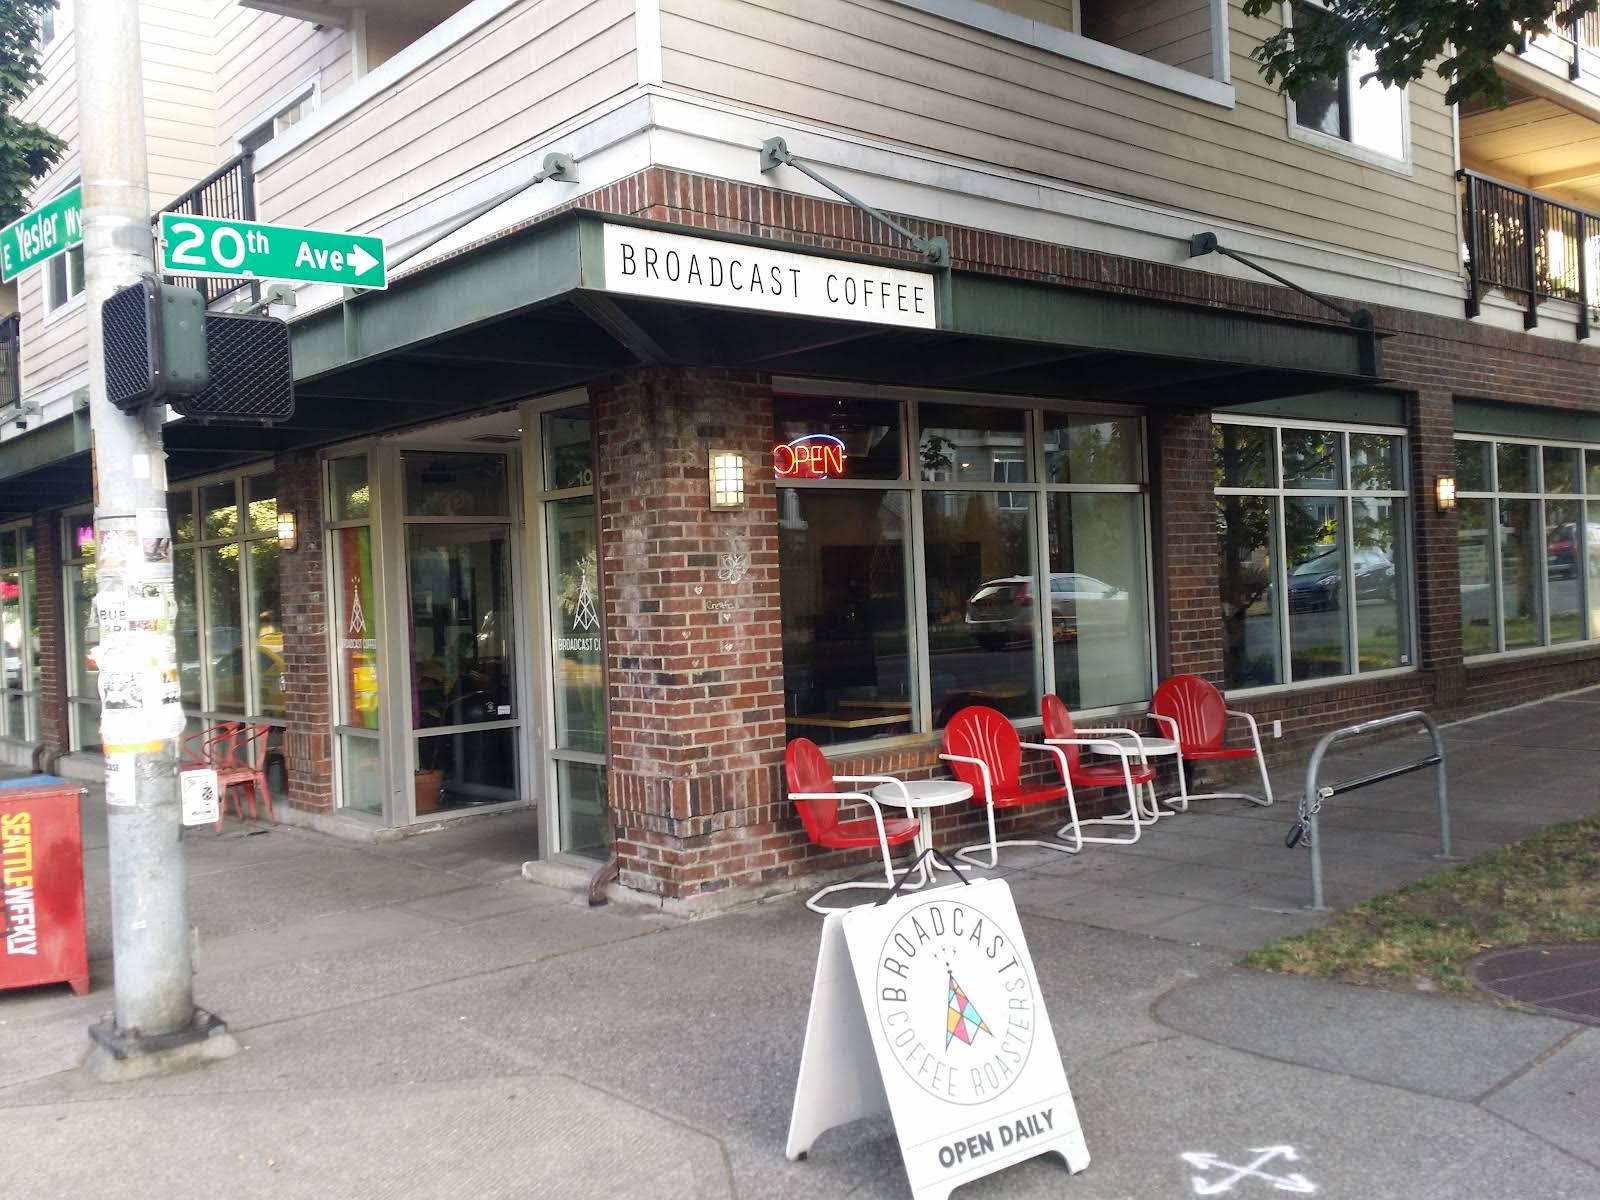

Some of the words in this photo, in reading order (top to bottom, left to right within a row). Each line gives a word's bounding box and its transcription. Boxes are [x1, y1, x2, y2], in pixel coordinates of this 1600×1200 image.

[3, 244, 12, 271] E
[15, 212, 58, 262] Yesler
[170, 222, 270, 269] 20th
[295, 241, 344, 272] Ave
[620, 243, 801, 298] BROADCAST
[826, 274, 925, 314] COFFEE
[773, 444, 843, 475] OPEN
[558, 638, 593, 651] BROADCAST
[1, 811, 33, 887] SEATTLE
[4, 885, 38, 956] WEEKLY
[882, 907, 1019, 1002] BROADCAST
[887, 1011, 958, 1096] COFFEE
[970, 978, 1030, 1097] ROASTERS
[938, 1131, 994, 1168] OPEN
[998, 1109, 1053, 1147] DAILY
